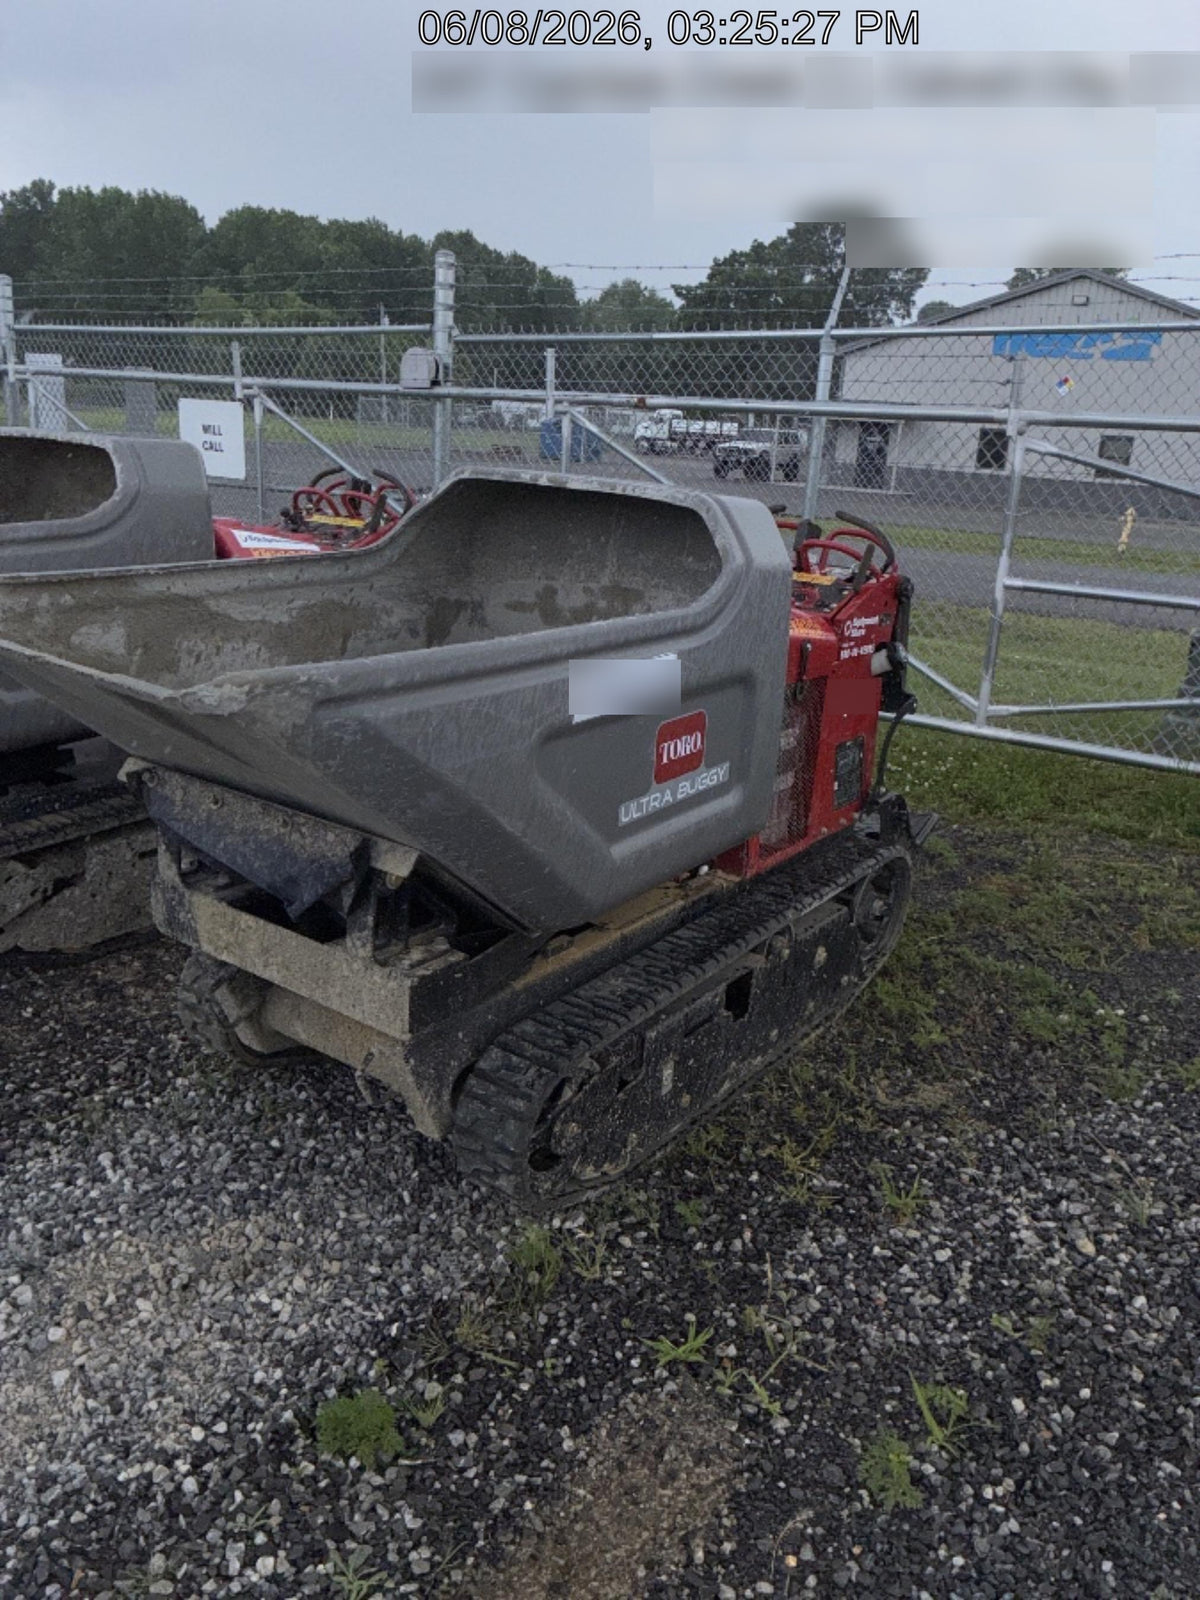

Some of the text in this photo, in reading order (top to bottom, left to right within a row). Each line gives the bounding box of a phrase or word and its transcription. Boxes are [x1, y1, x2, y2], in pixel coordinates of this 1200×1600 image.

[202, 424, 222, 436] WILL
[202, 440, 224, 453] CALL
[660, 731, 701, 765] TORO
[620, 766, 727, 822] ULTRA BUGGY
